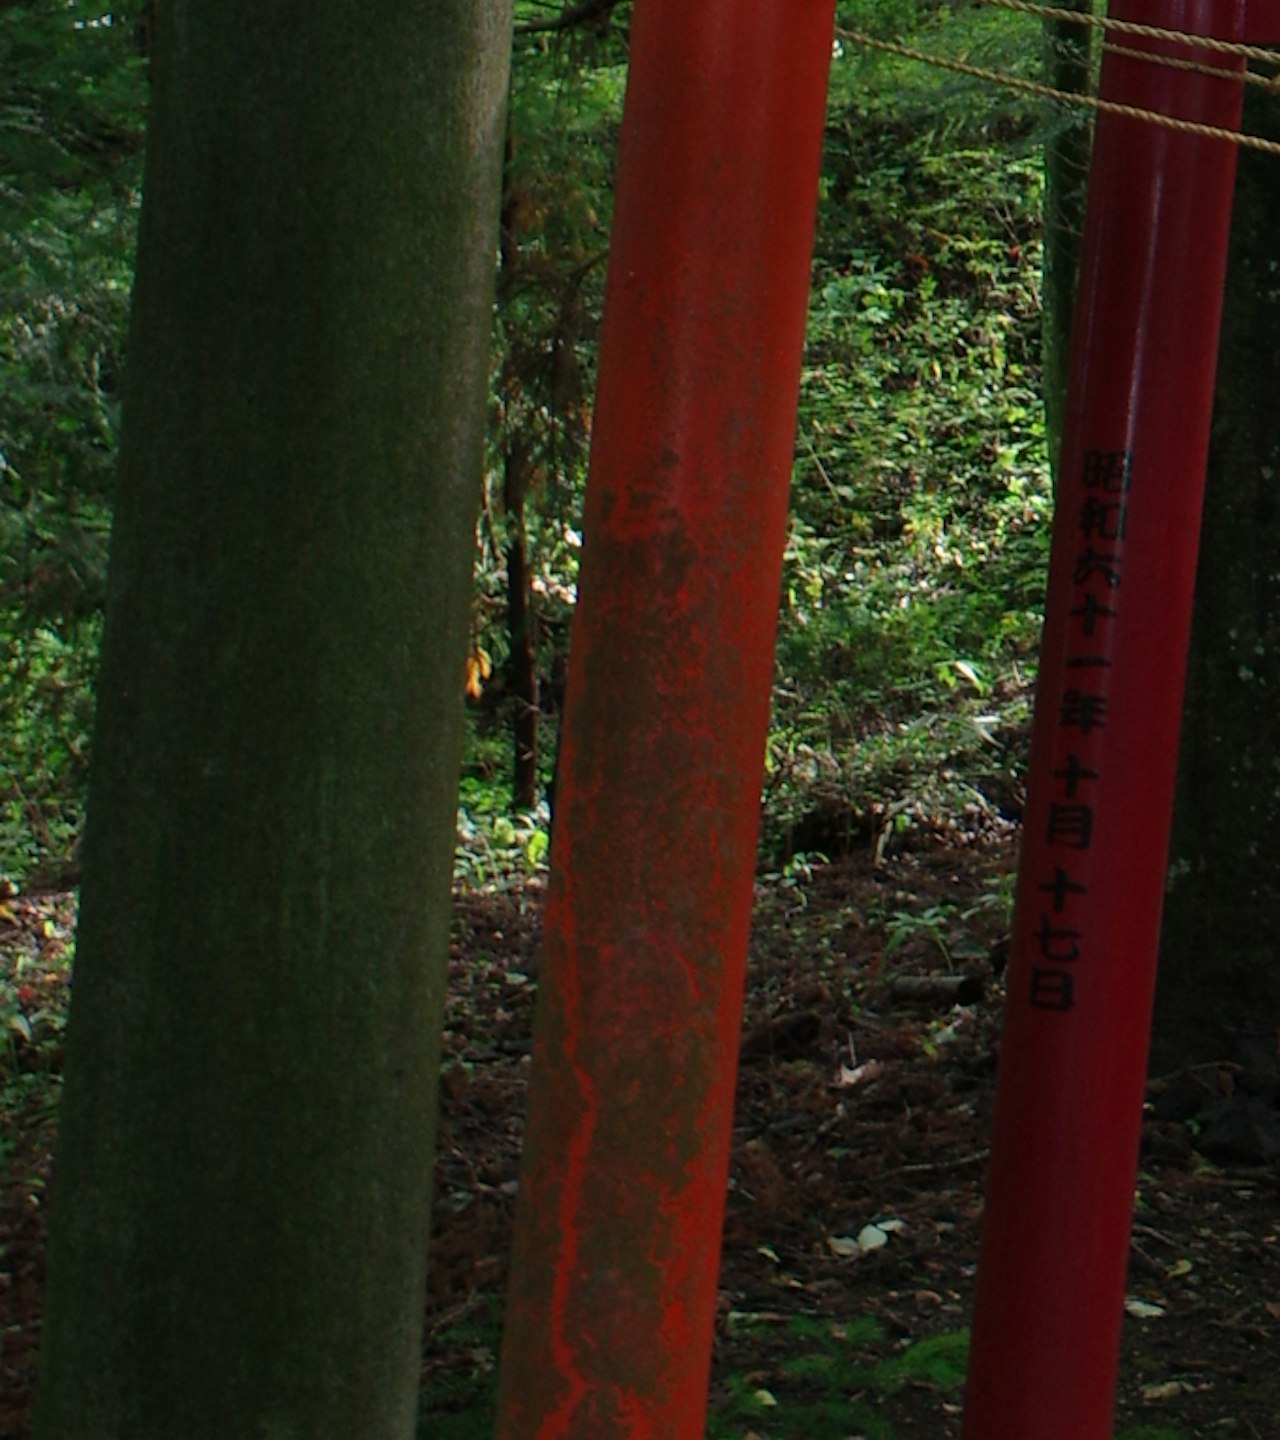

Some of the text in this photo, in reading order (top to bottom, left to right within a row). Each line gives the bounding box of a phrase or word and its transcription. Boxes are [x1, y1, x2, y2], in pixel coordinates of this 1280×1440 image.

[1030, 447, 1132, 1012] 昭和六十一年十月十七日
